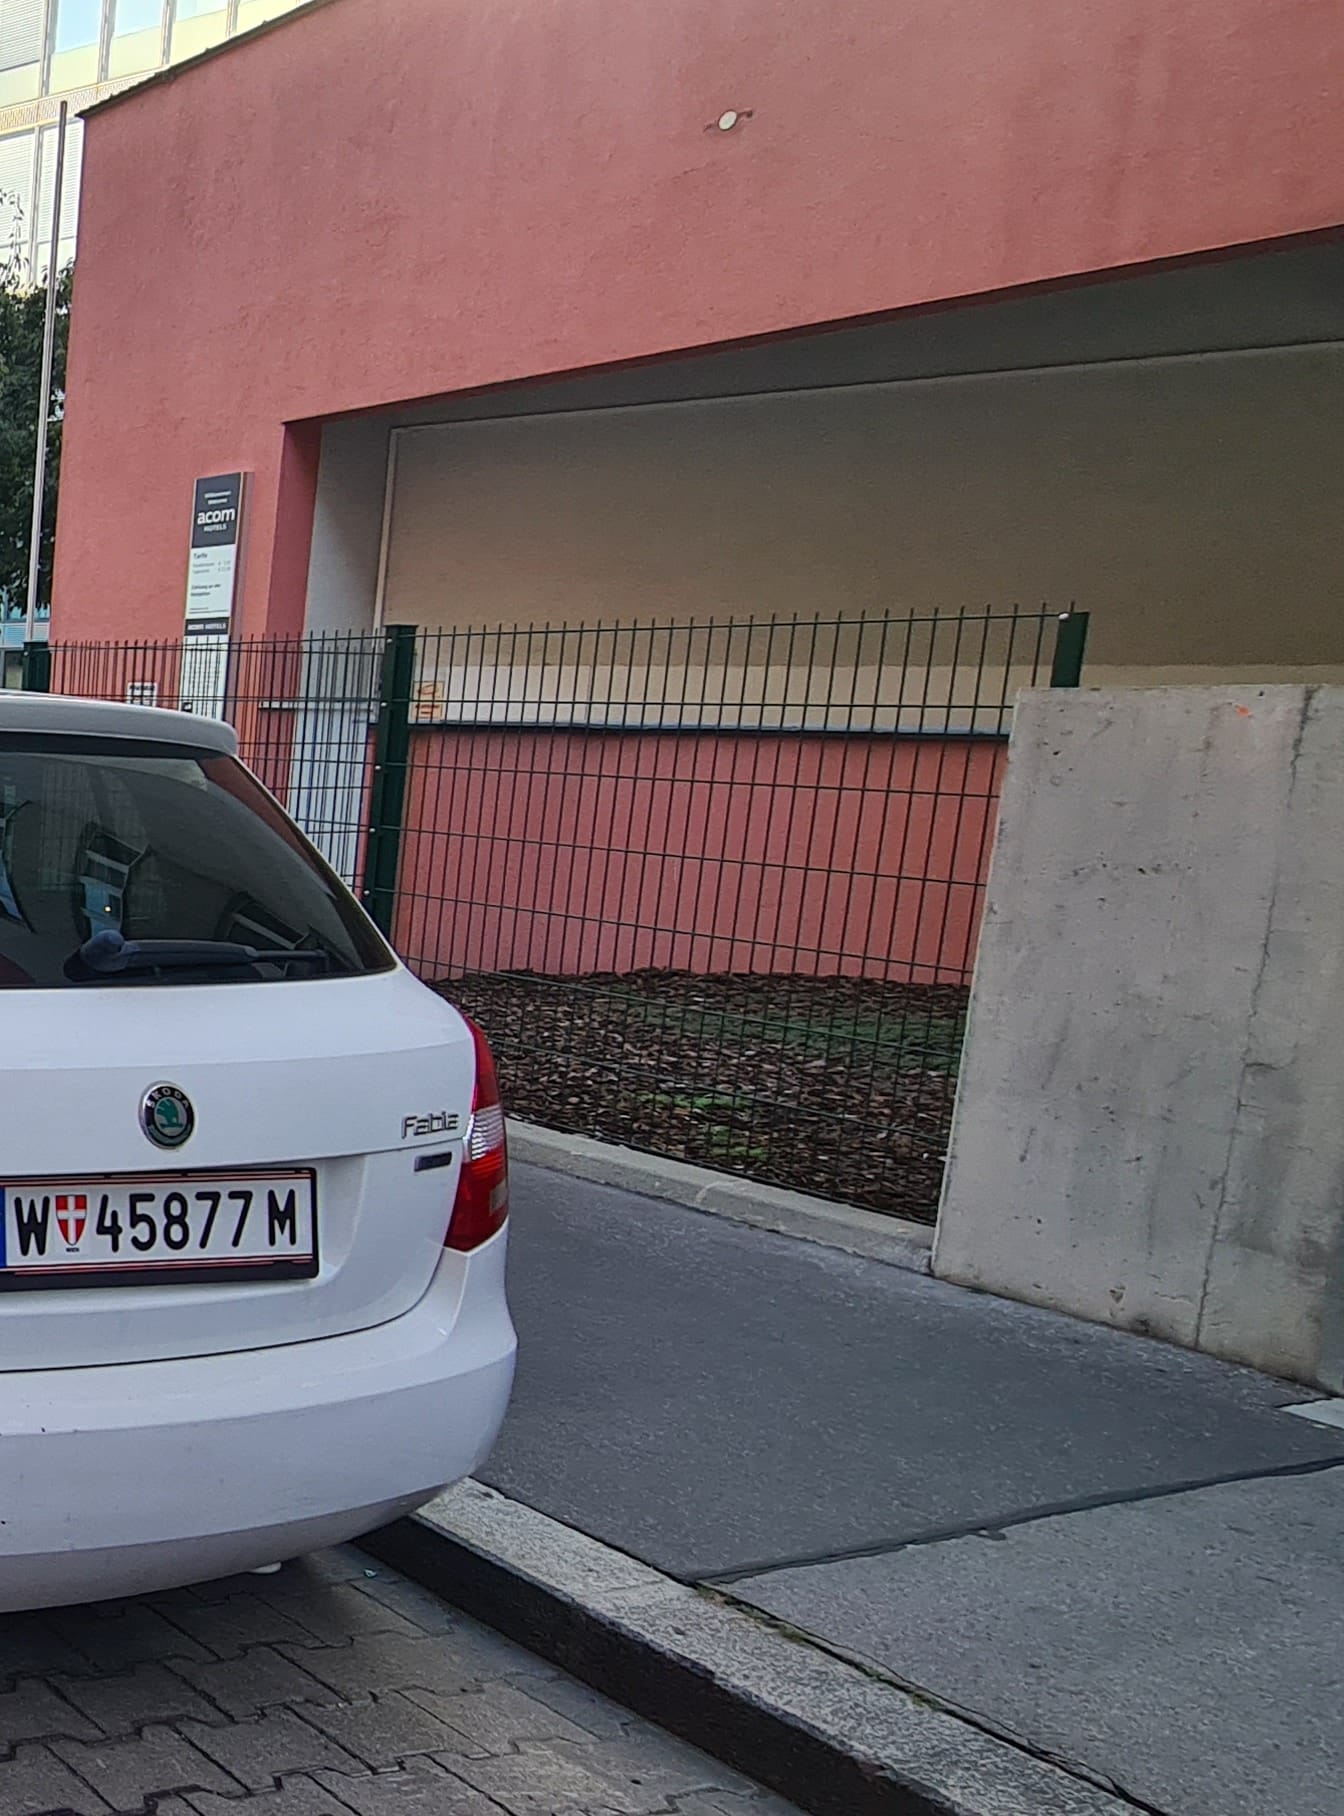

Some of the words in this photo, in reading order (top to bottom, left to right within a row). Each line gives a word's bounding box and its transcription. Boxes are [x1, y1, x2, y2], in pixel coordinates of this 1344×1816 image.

[197, 508, 236, 525] acom
[401, 1111, 459, 1139] Fabia
[14, 1195, 50, 1257] W
[96, 1190, 253, 1253] 45877
[267, 1189, 297, 1247] M
